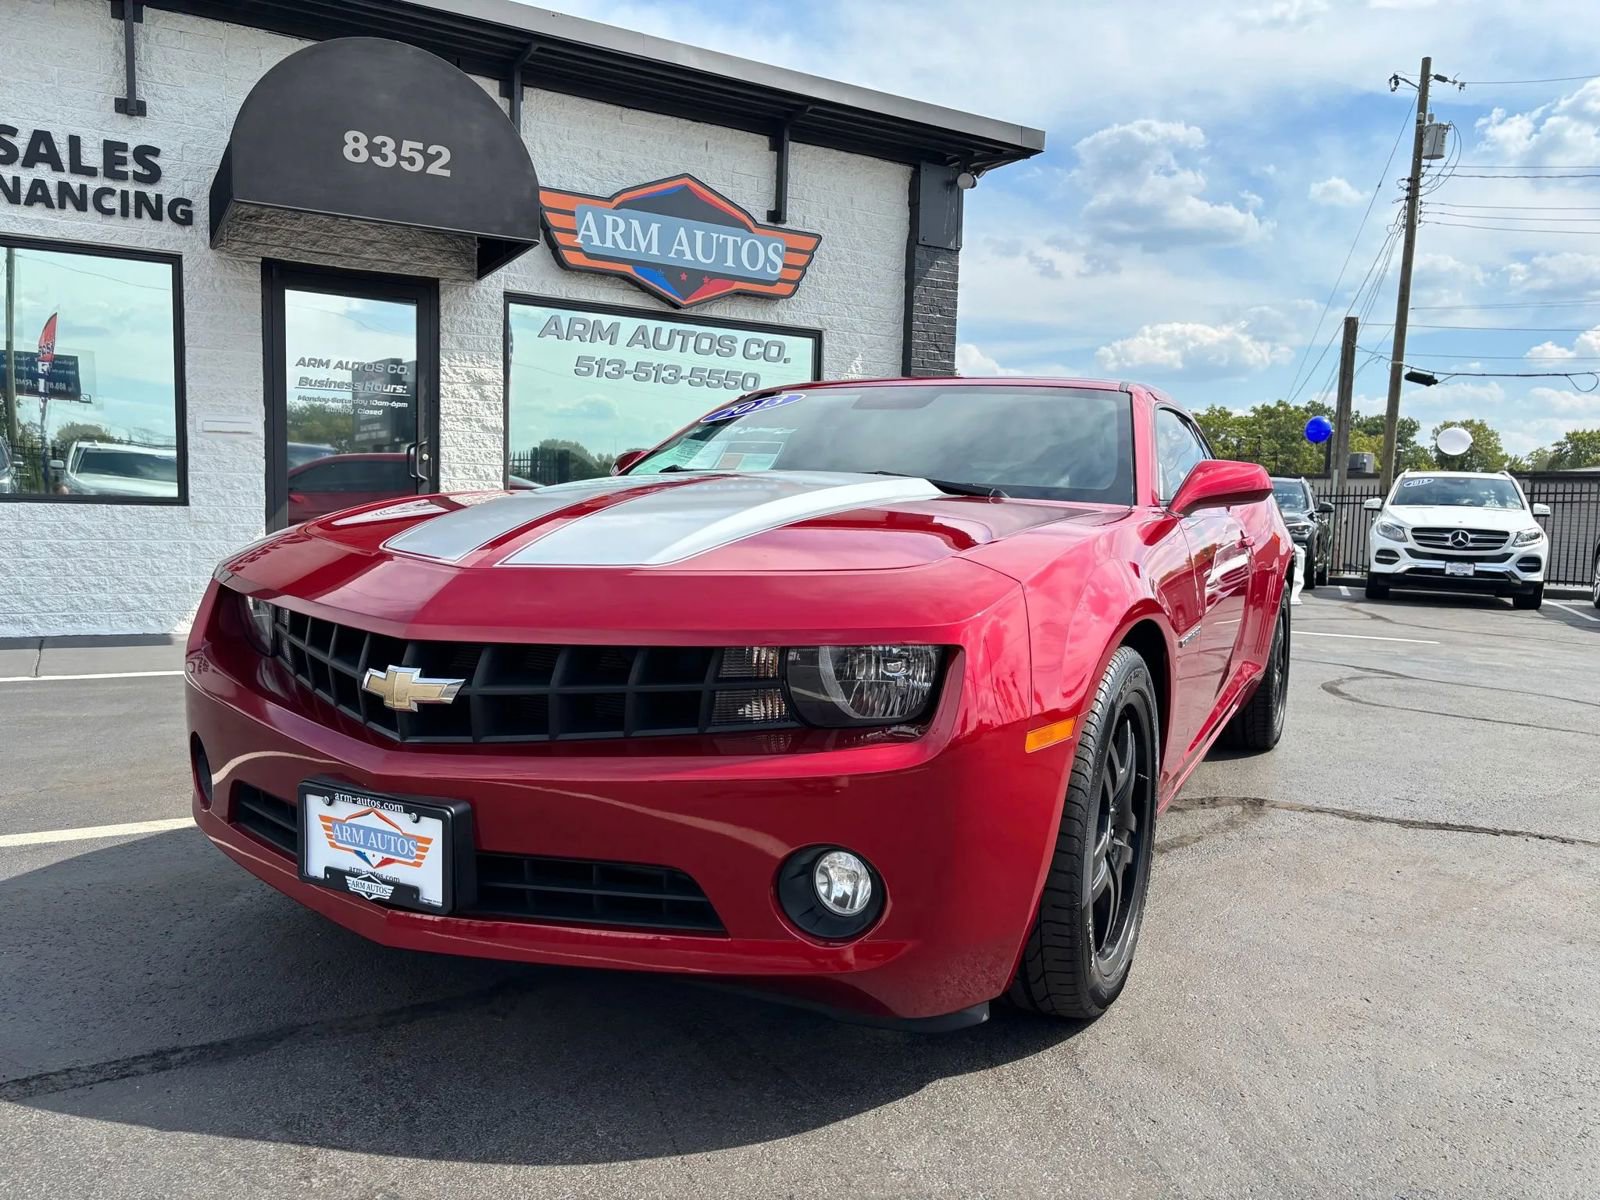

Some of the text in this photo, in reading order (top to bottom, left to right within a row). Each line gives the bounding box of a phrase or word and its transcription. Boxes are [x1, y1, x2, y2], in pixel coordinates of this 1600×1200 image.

[0, 124, 162, 184] SALES
[343, 130, 451, 177] 8352
[574, 211, 783, 274] ARM AUTOS
[538, 314, 792, 364] ARM AUTOS CO.
[295, 356, 410, 376] ARM AUTOS CO.
[574, 355, 761, 391] 513-513-5550
[298, 376, 408, 394] Business Hours:
[357, 407, 384, 417] Closed
[369, 399, 409, 409] 10am-6pm
[334, 792, 404, 813] arm-autos.com
[333, 823, 417, 857] ARM AUTOS
[350, 879, 389, 896] ARM AUTOS
